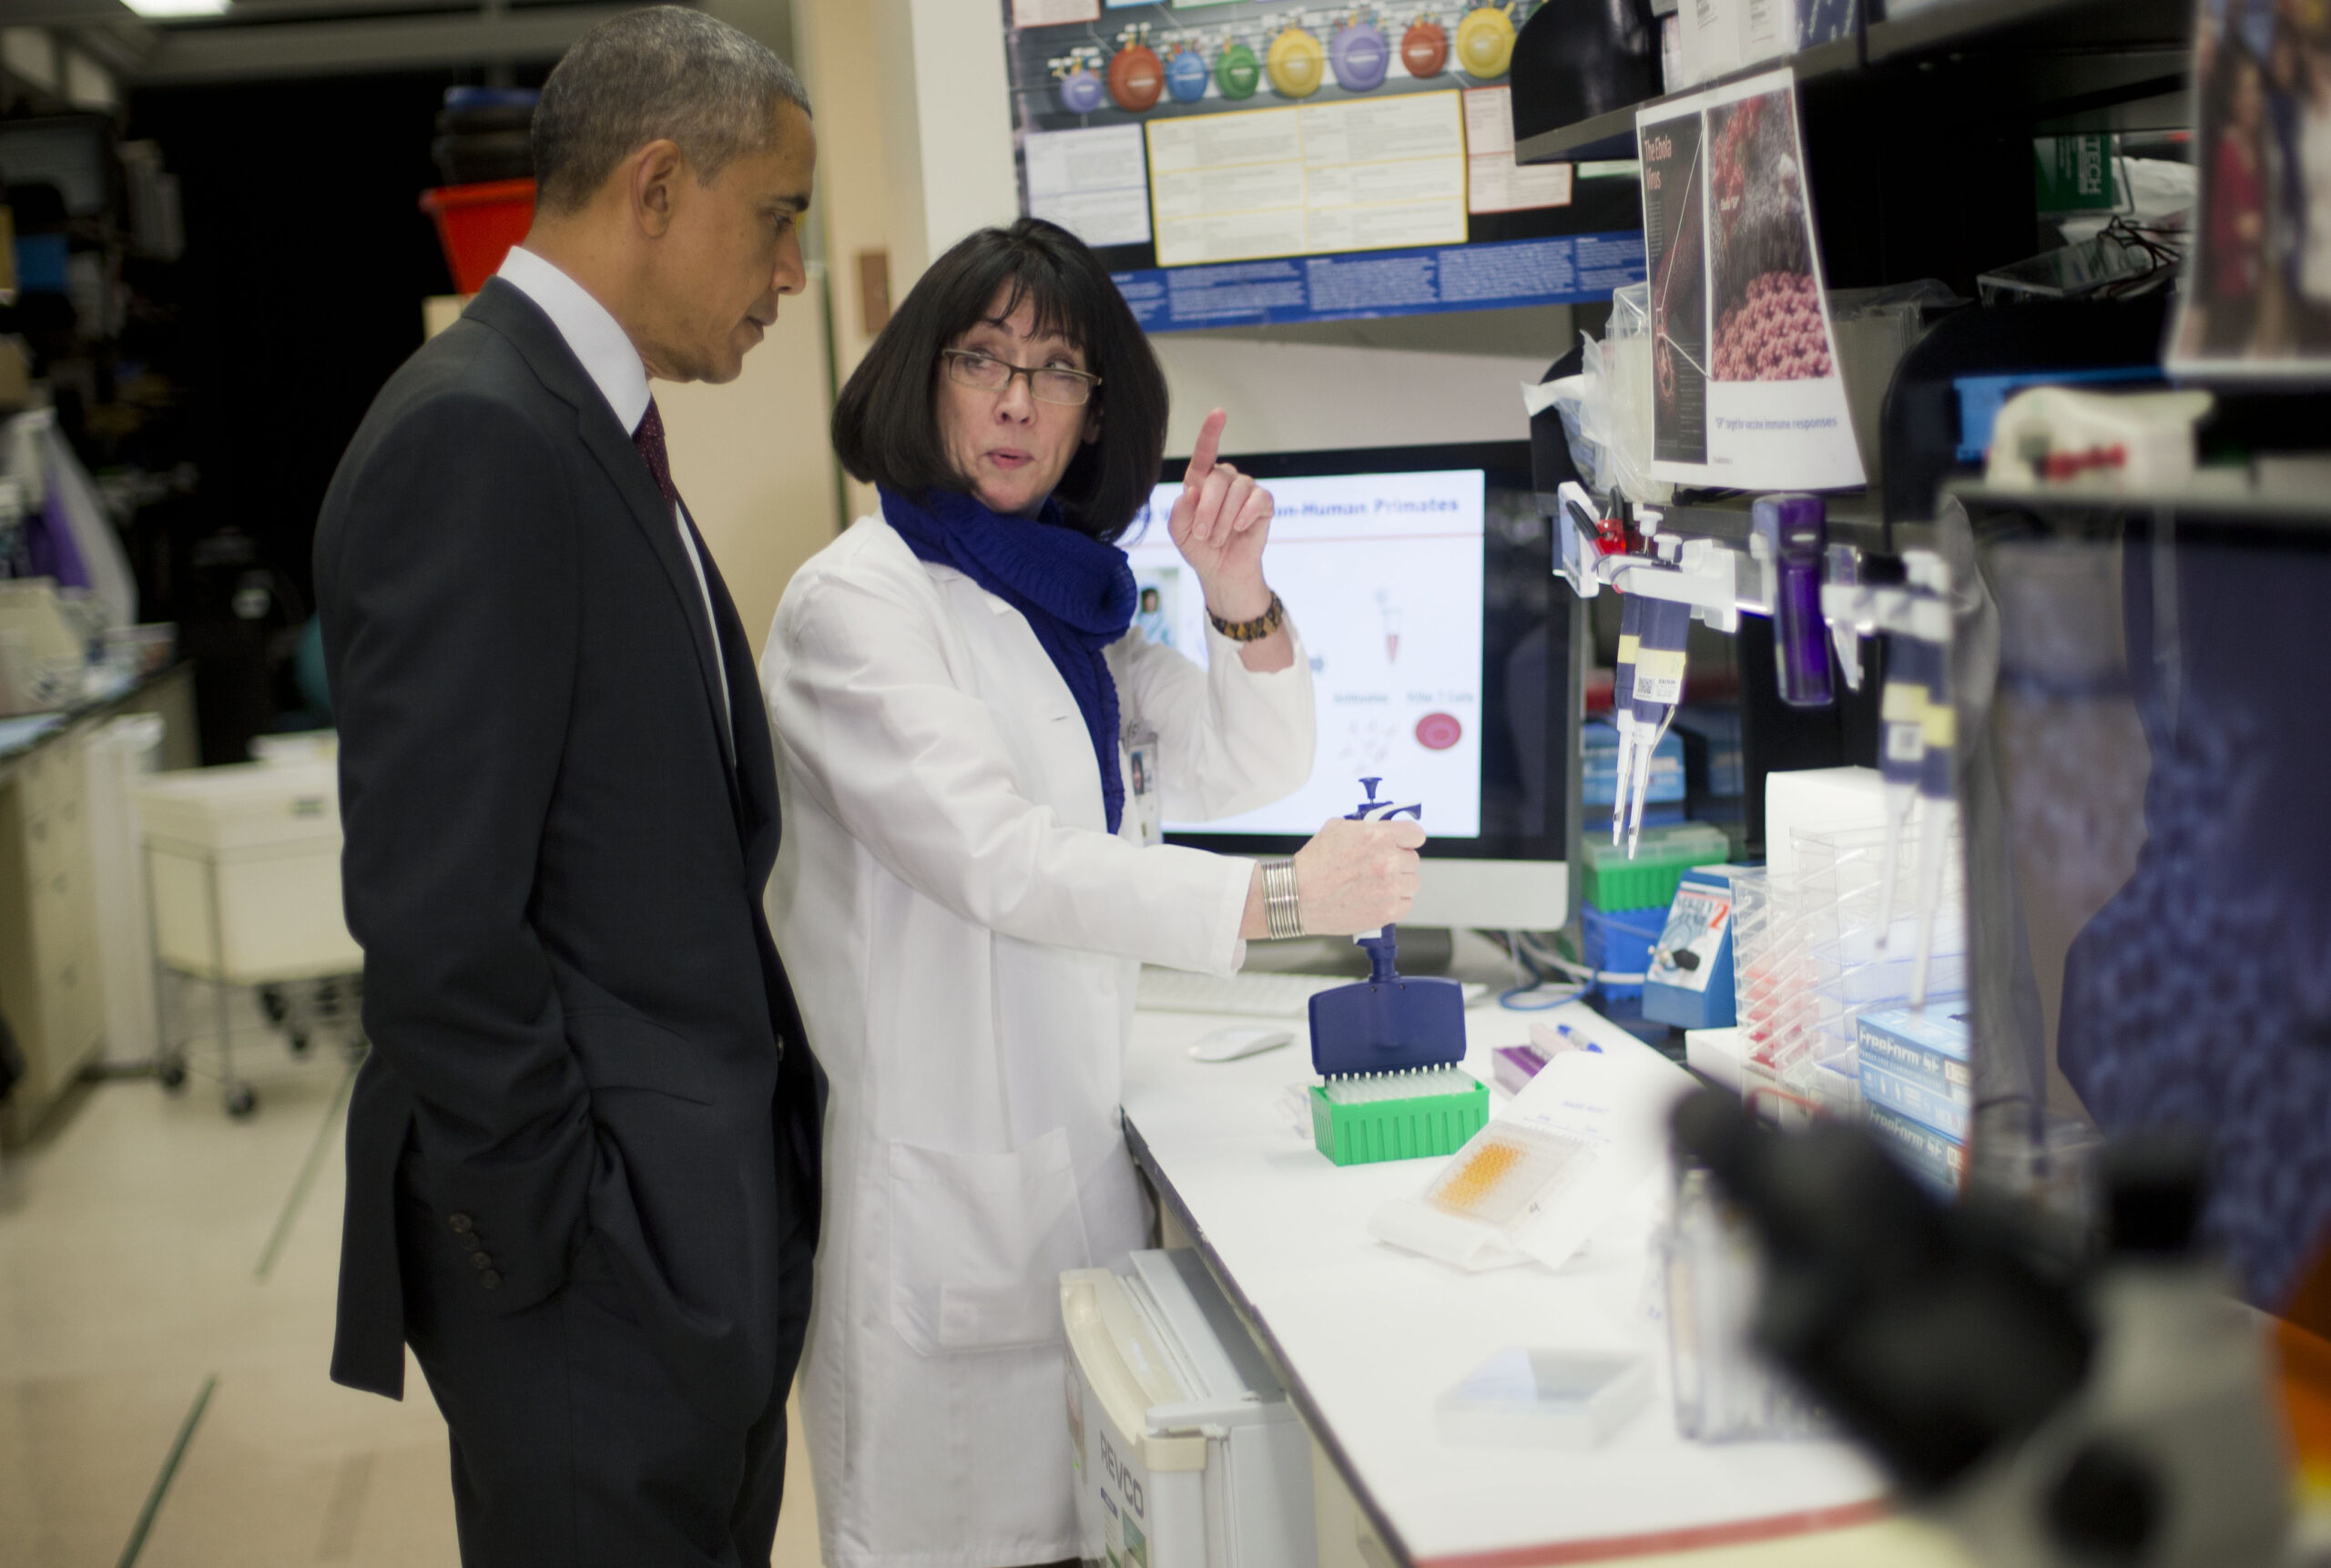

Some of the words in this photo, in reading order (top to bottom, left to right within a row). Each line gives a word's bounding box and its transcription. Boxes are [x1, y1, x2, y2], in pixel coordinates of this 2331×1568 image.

[1644, 138, 1655, 162] The
[1655, 134, 1672, 160] Ebola
[1645, 167, 1661, 190] Virus
[1765, 417, 1791, 430] immune
[1792, 416, 1838, 432] responses
[1274, 502, 1367, 517] on-Human
[1374, 497, 1459, 514] Primates
[1709, 902, 1729, 931] 2
[1859, 1026, 1919, 1065] FreeForm
[1869, 1105, 1924, 1149] FreeForm
[1100, 1428, 1145, 1520] REVCO
